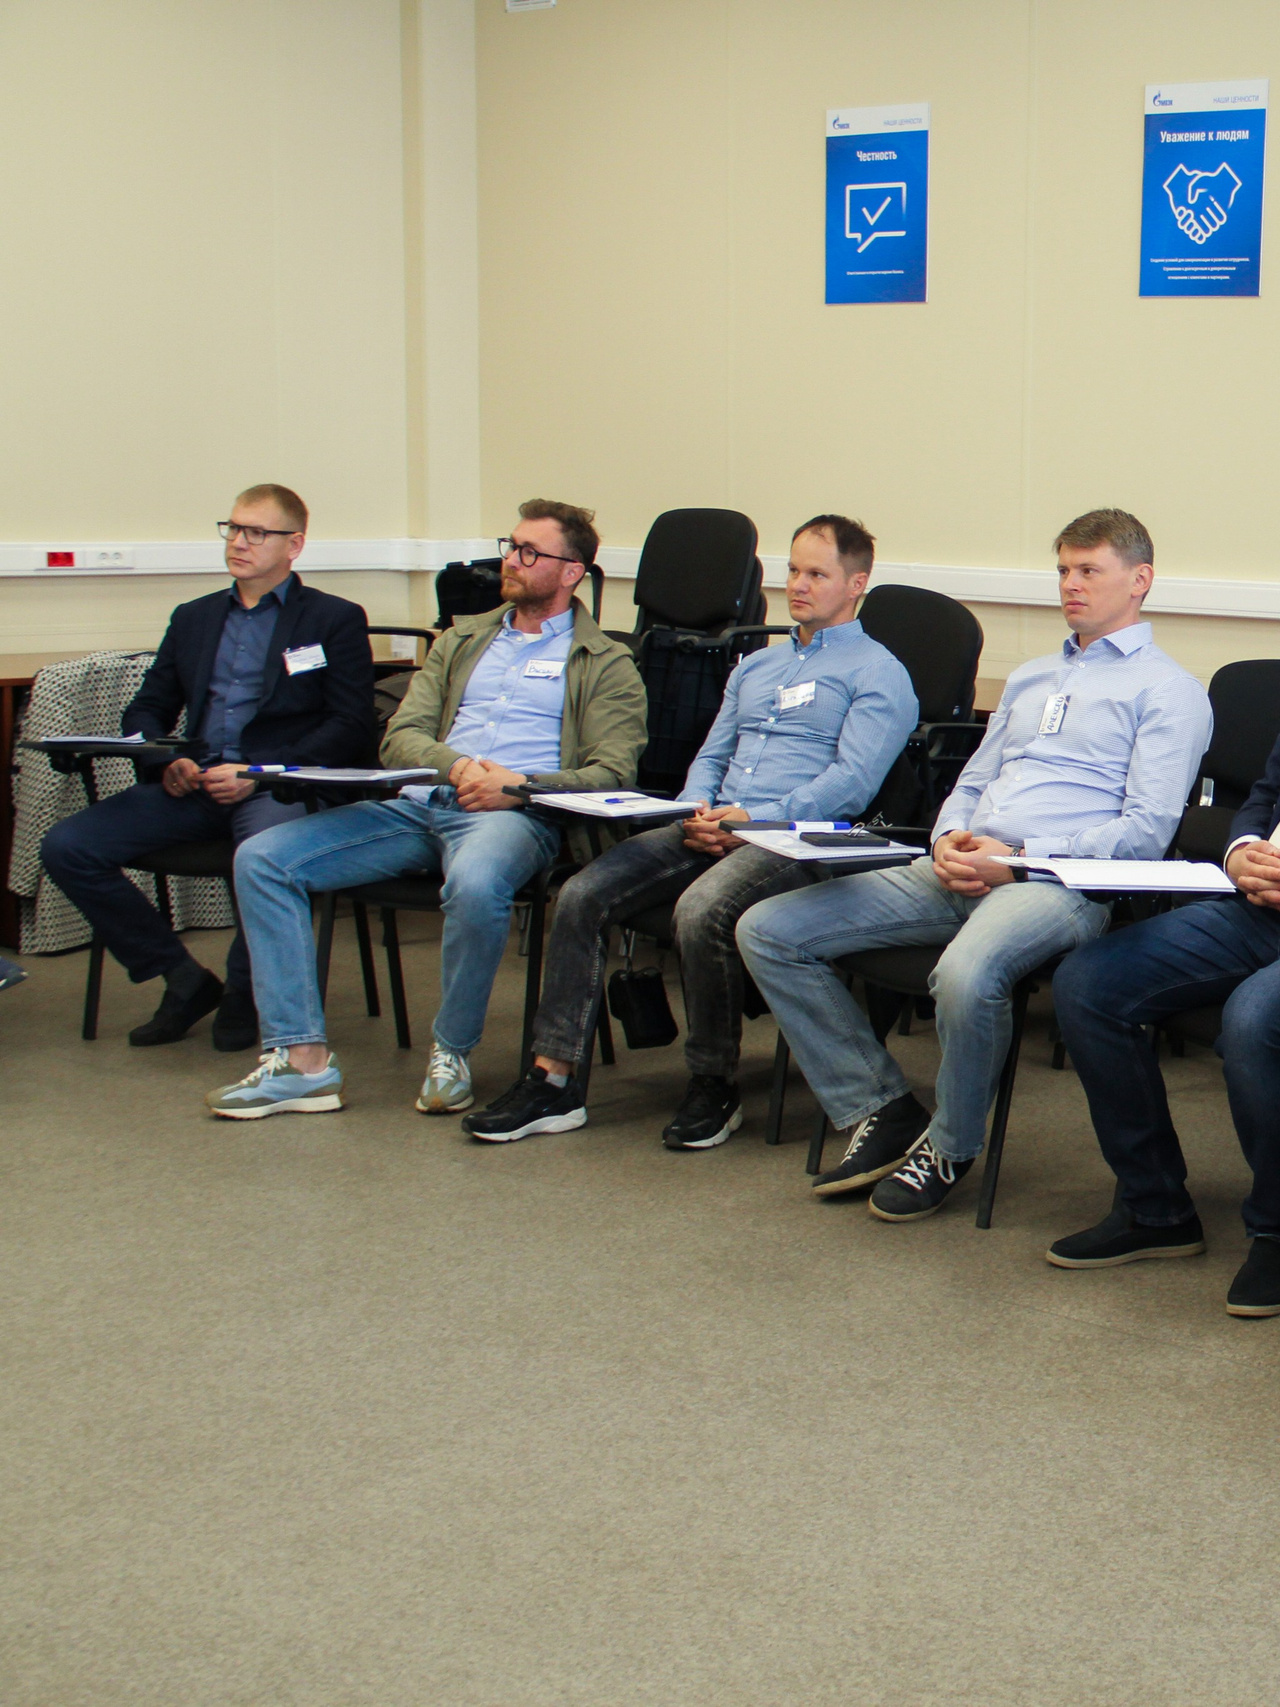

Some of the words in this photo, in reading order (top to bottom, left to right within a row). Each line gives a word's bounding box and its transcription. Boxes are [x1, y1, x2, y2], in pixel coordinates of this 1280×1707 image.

[1212, 96, 1230, 104] НАШИ
[1230, 94, 1260, 104] ЦЕННОСТИ
[1159, 129, 1206, 144] Уважение
[1208, 131, 1214, 141] к
[1216, 129, 1250, 143] людям
[856, 150, 898, 162] Честность
